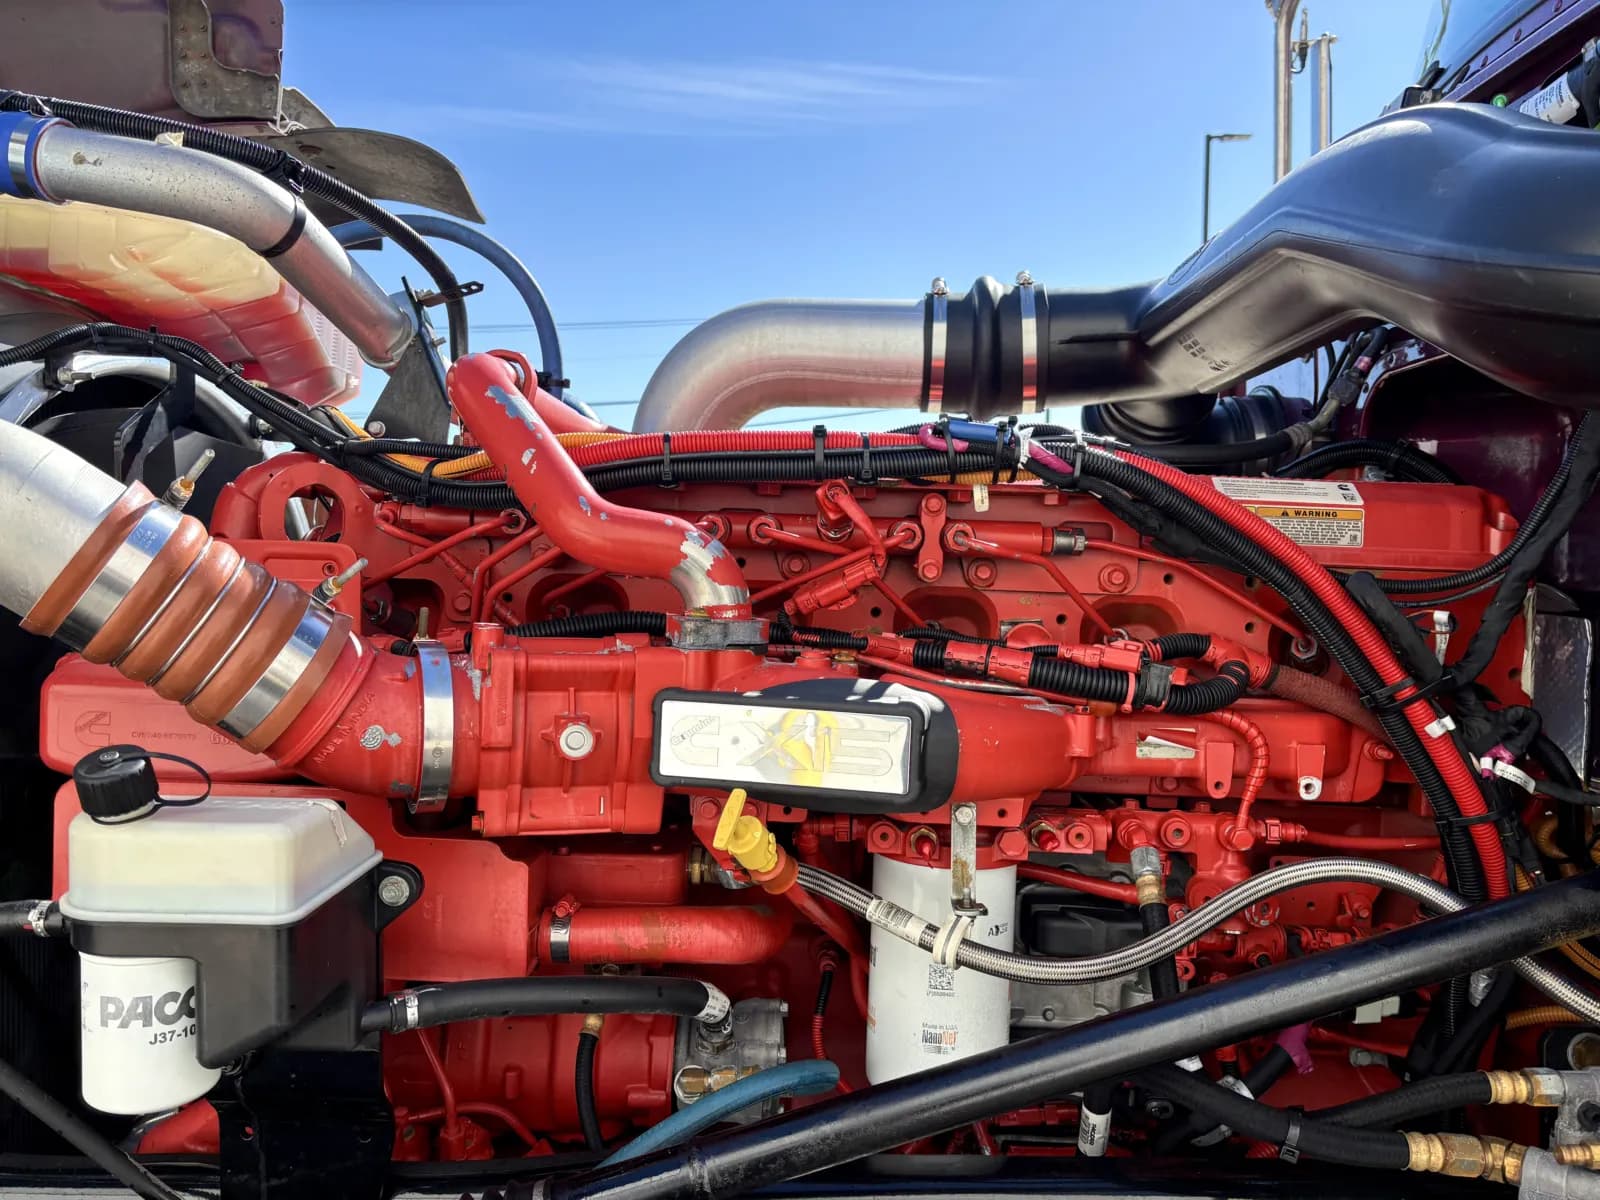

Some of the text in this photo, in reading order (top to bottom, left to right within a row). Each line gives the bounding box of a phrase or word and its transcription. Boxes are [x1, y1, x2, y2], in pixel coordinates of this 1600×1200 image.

[1294, 510, 1338, 518] WARNING
[312, 737, 342, 764] MADE
[351, 692, 376, 724] INDIA
[149, 1024, 196, 1045] J37-10
[921, 1029, 959, 1046] NanoNet
